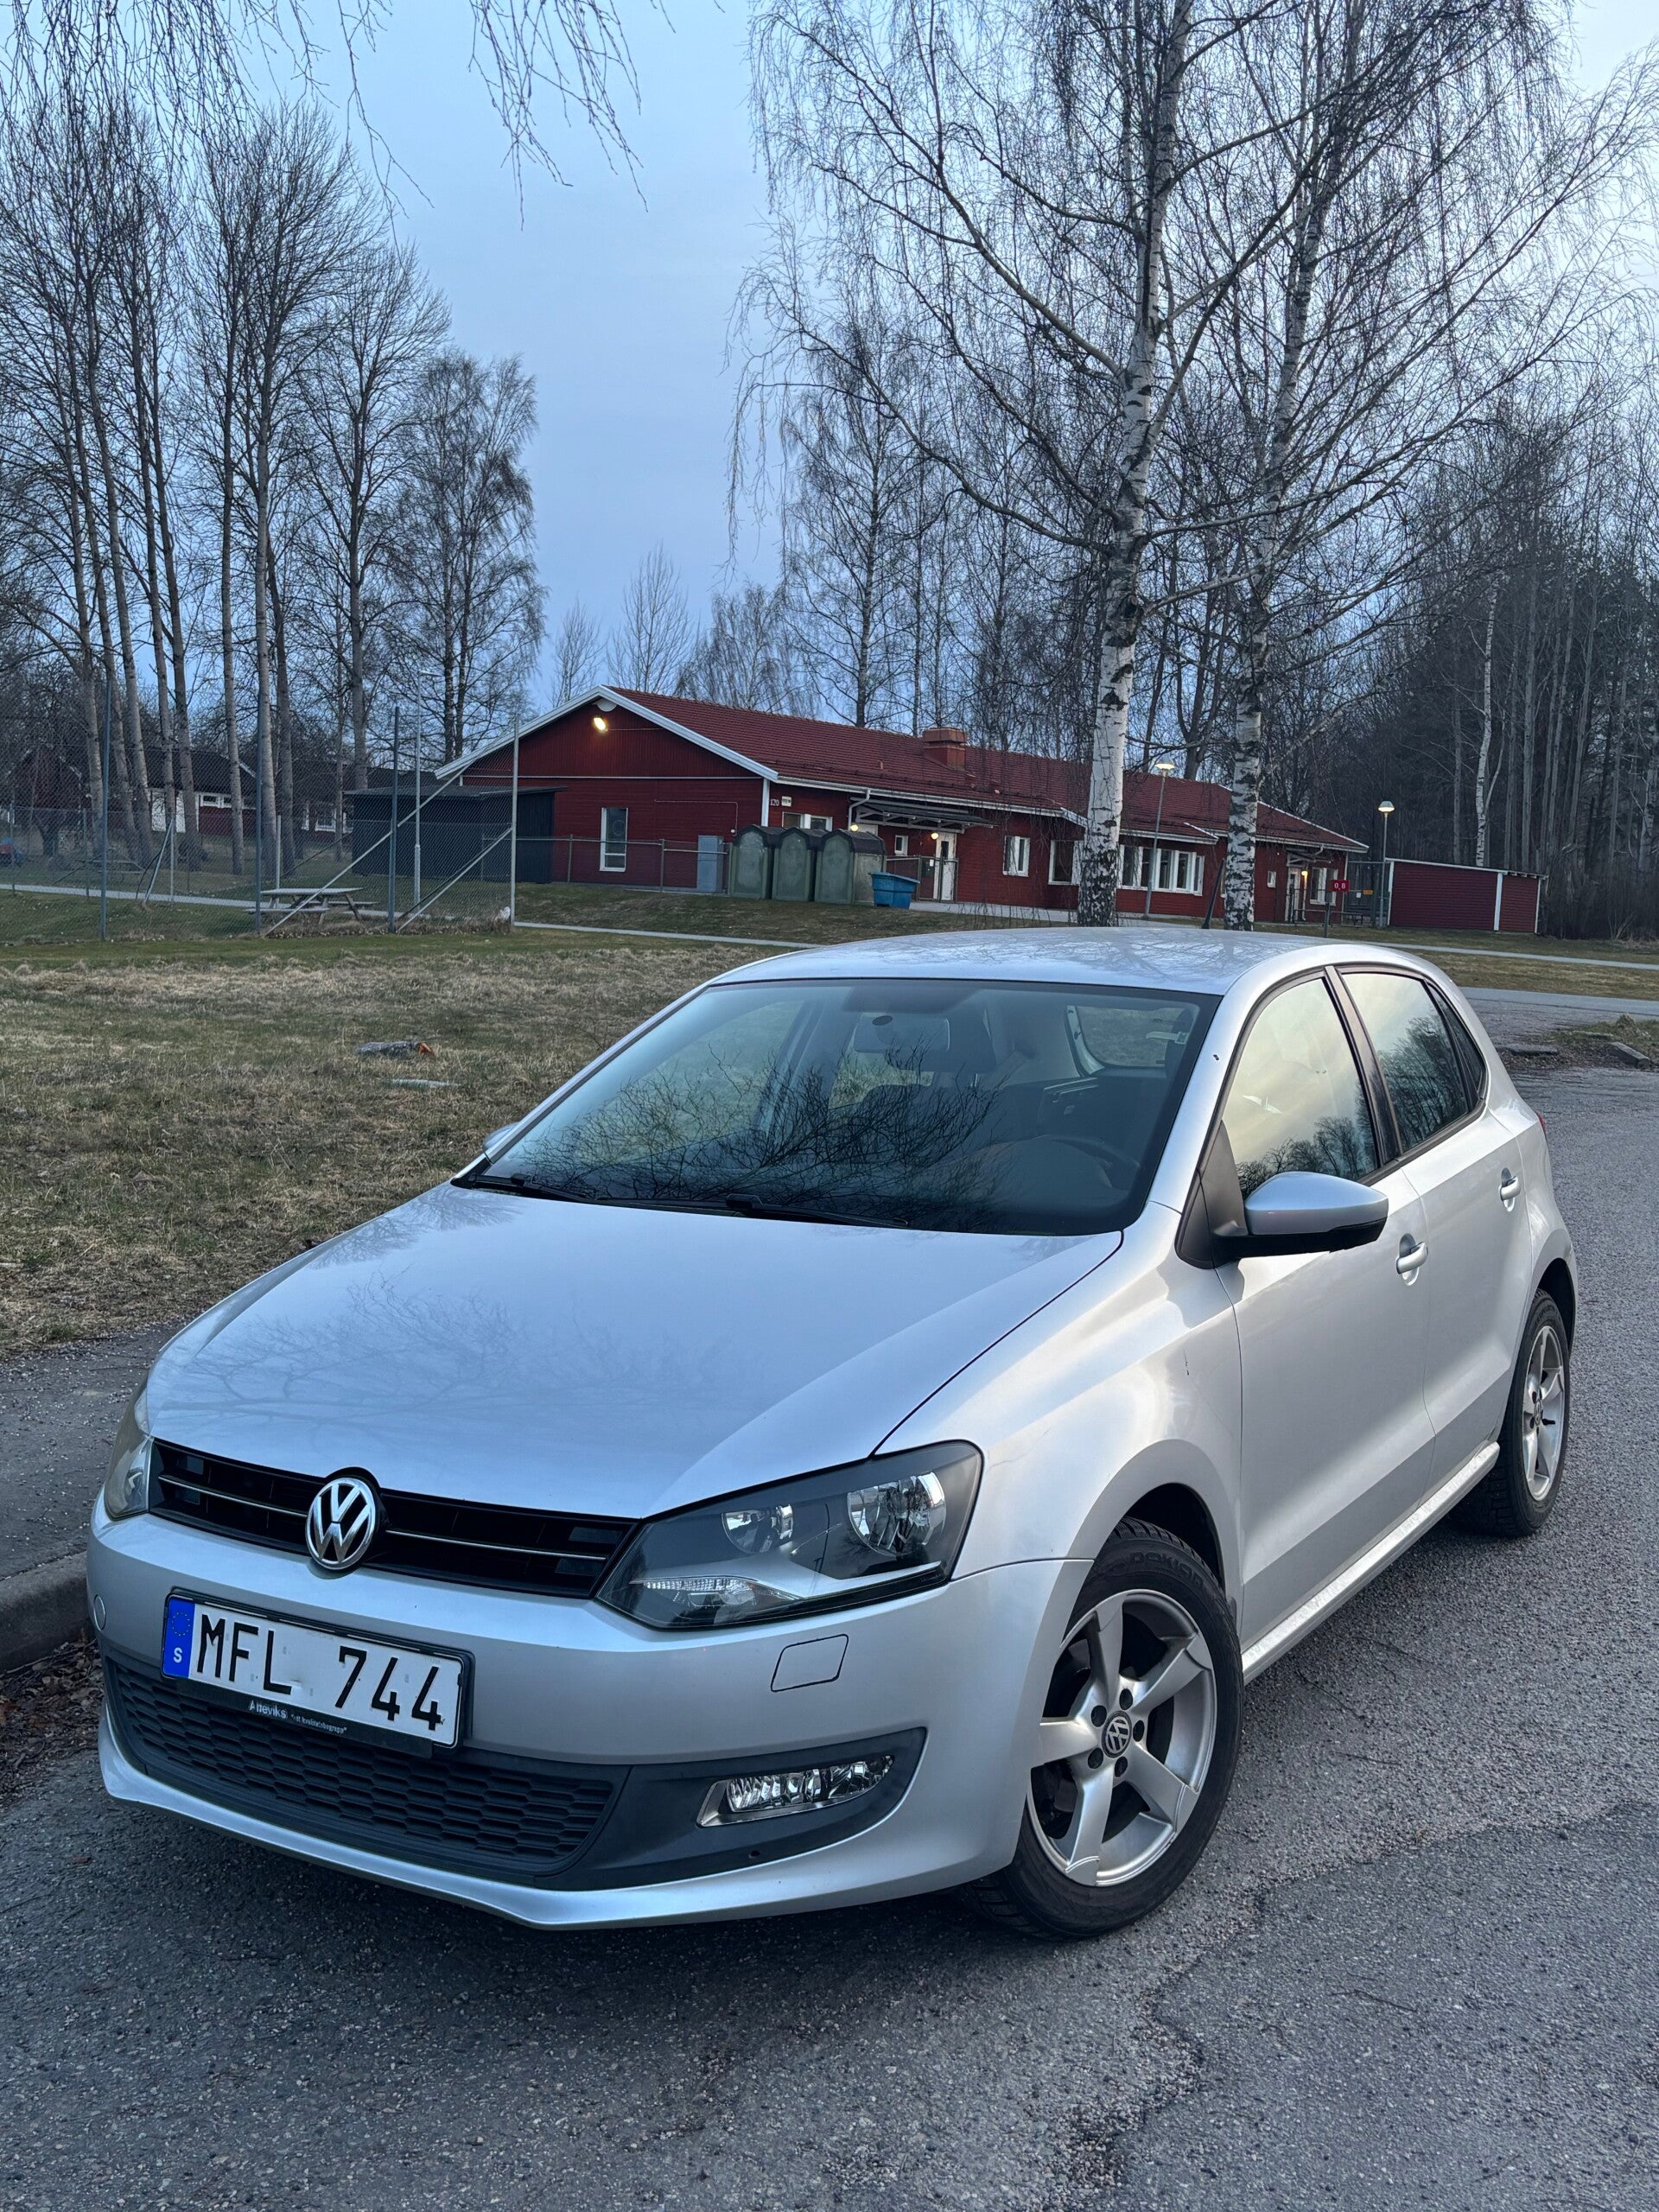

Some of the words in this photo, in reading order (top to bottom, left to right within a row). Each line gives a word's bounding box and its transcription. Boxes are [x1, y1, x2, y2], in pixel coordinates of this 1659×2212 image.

[173, 1647, 183, 1663] S
[197, 1613, 292, 1695] MFL
[335, 1645, 442, 1732] 744
